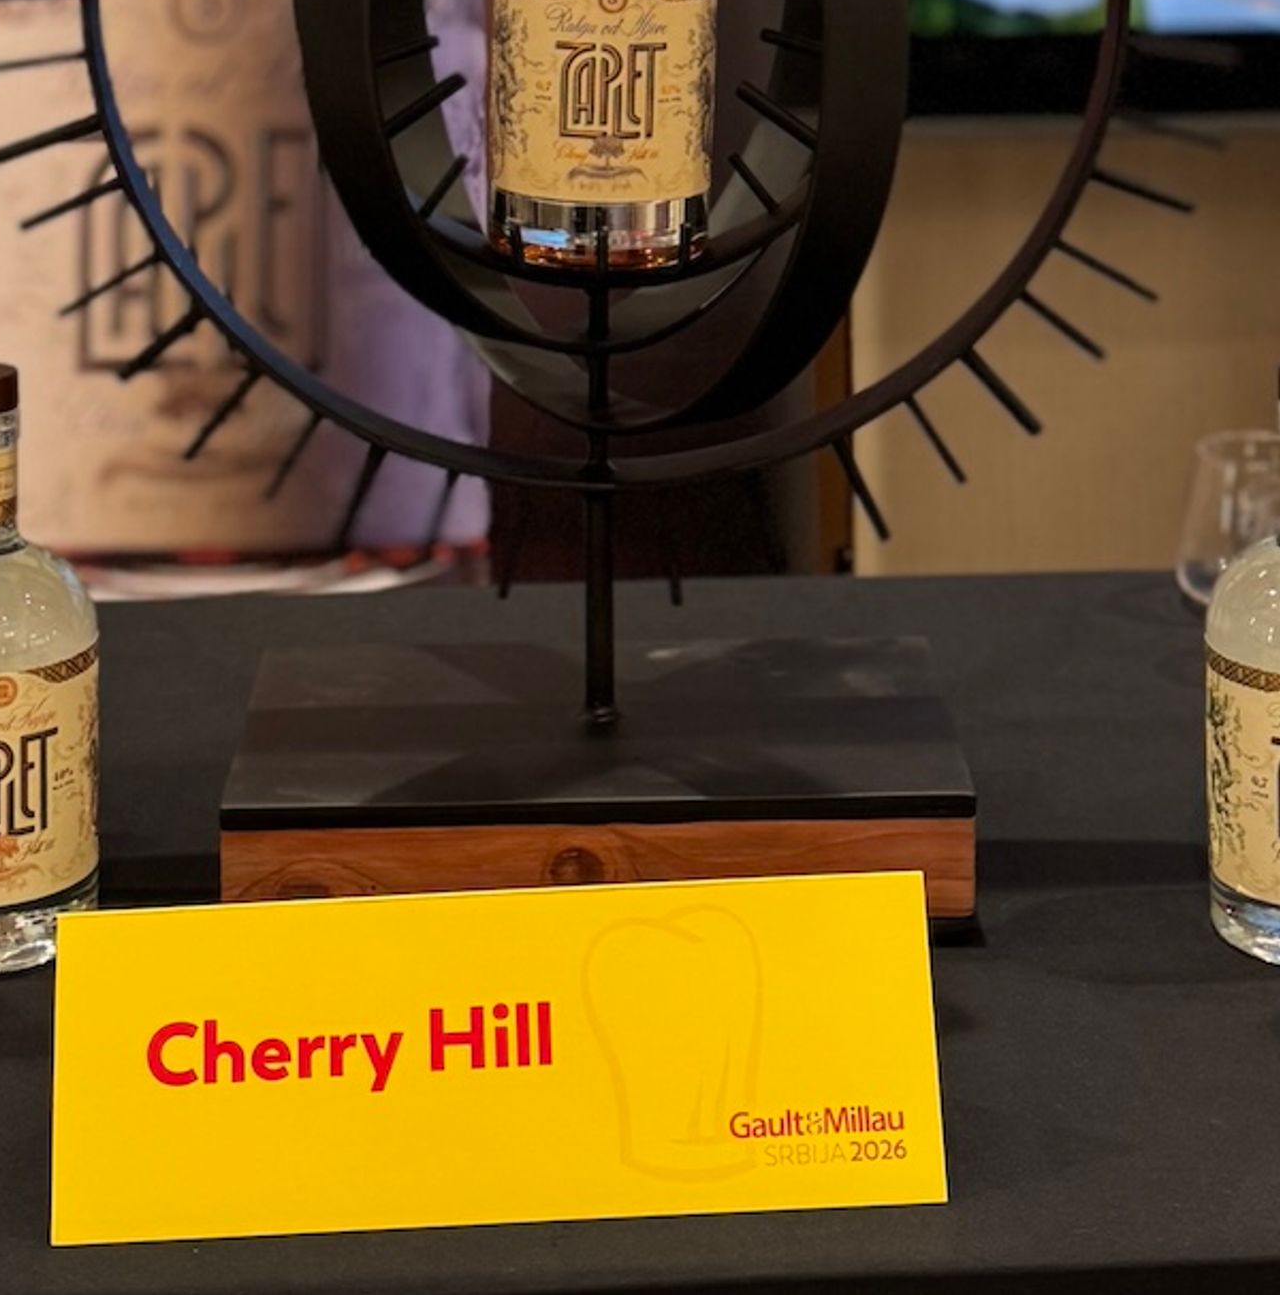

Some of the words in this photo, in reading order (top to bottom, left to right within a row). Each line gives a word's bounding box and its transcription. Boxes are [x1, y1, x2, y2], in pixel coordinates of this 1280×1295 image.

[147, 1020, 404, 1093] Cherry
[429, 1001, 552, 1072] Hill
[729, 1105, 904, 1139] Gault&Millau
[764, 1143, 847, 1166] SRBIJA
[850, 1139, 907, 1162] 2026
